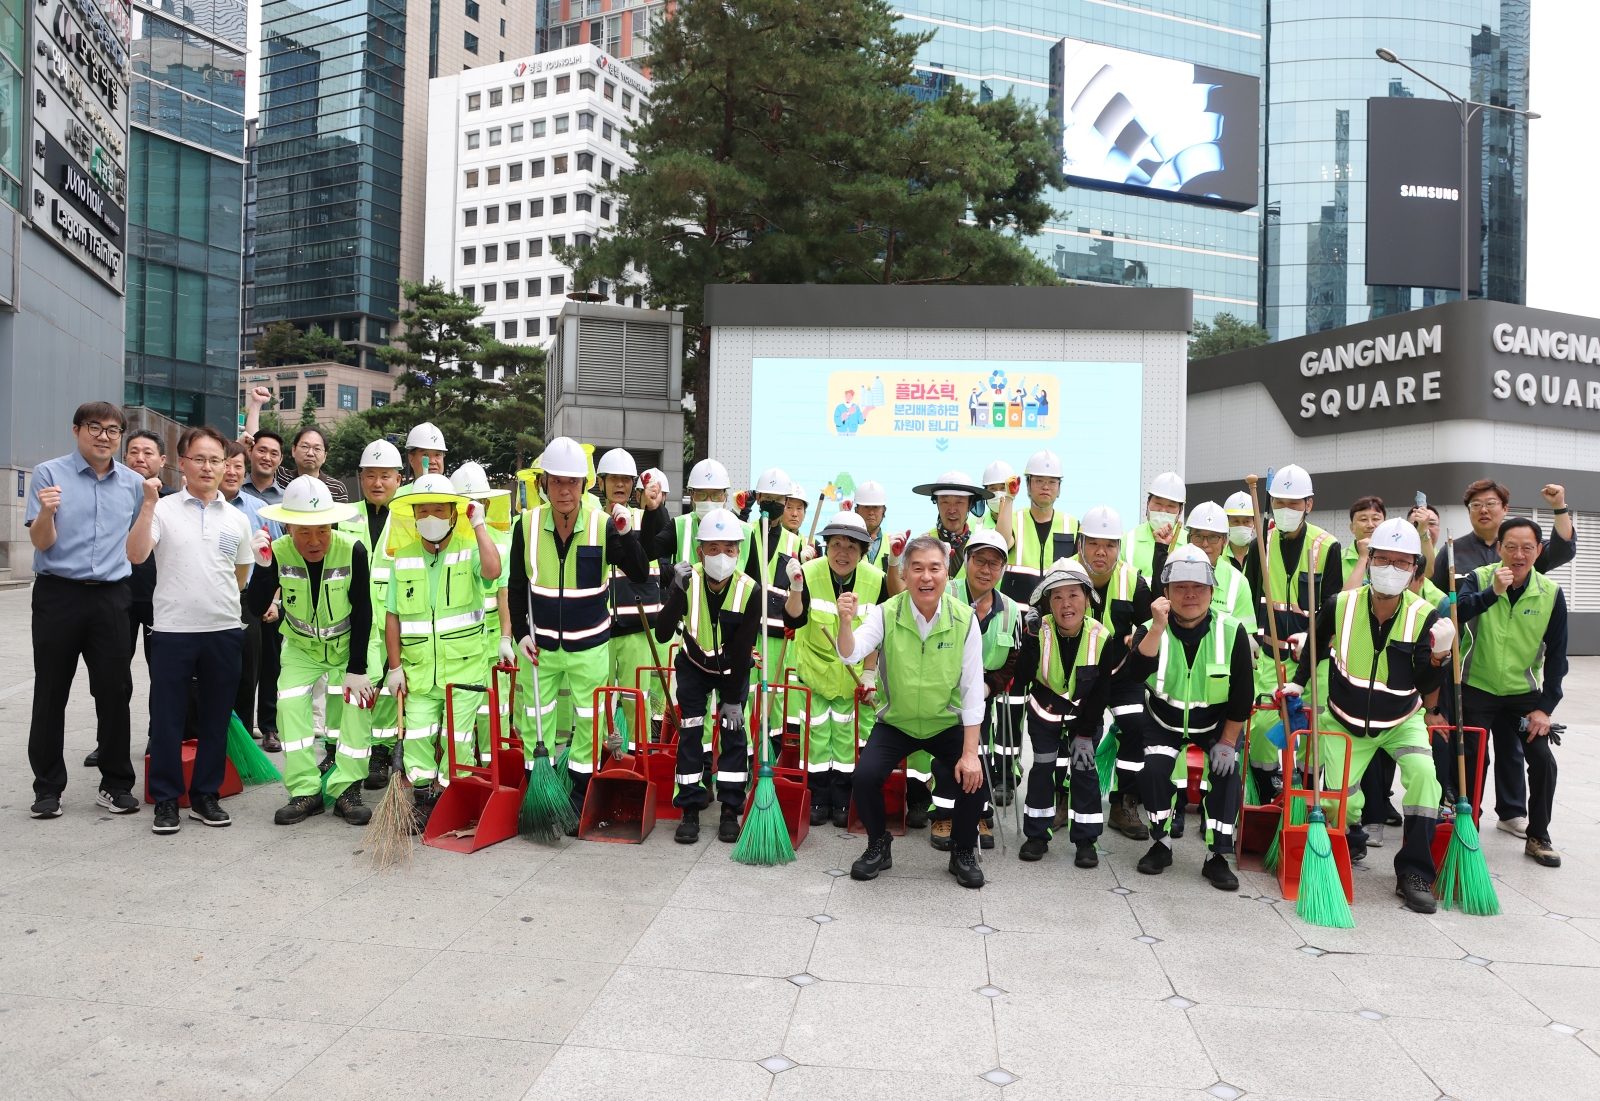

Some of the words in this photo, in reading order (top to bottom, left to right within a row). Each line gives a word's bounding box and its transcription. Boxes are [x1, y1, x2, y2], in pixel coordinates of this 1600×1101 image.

[544, 55, 582, 70] YOUNGLIM
[1400, 184, 1459, 201] SAMSUNG
[56, 199, 87, 247] Lagom
[88, 227, 120, 277] Training
[1299, 324, 1442, 378] GANGNAM
[895, 383, 958, 401] 플라스틱,
[1299, 371, 1441, 419] SQUARE
[894, 404, 959, 417] 분리배출하면
[893, 419, 925, 432] 자원이
[928, 419, 959, 433] 됩니다
